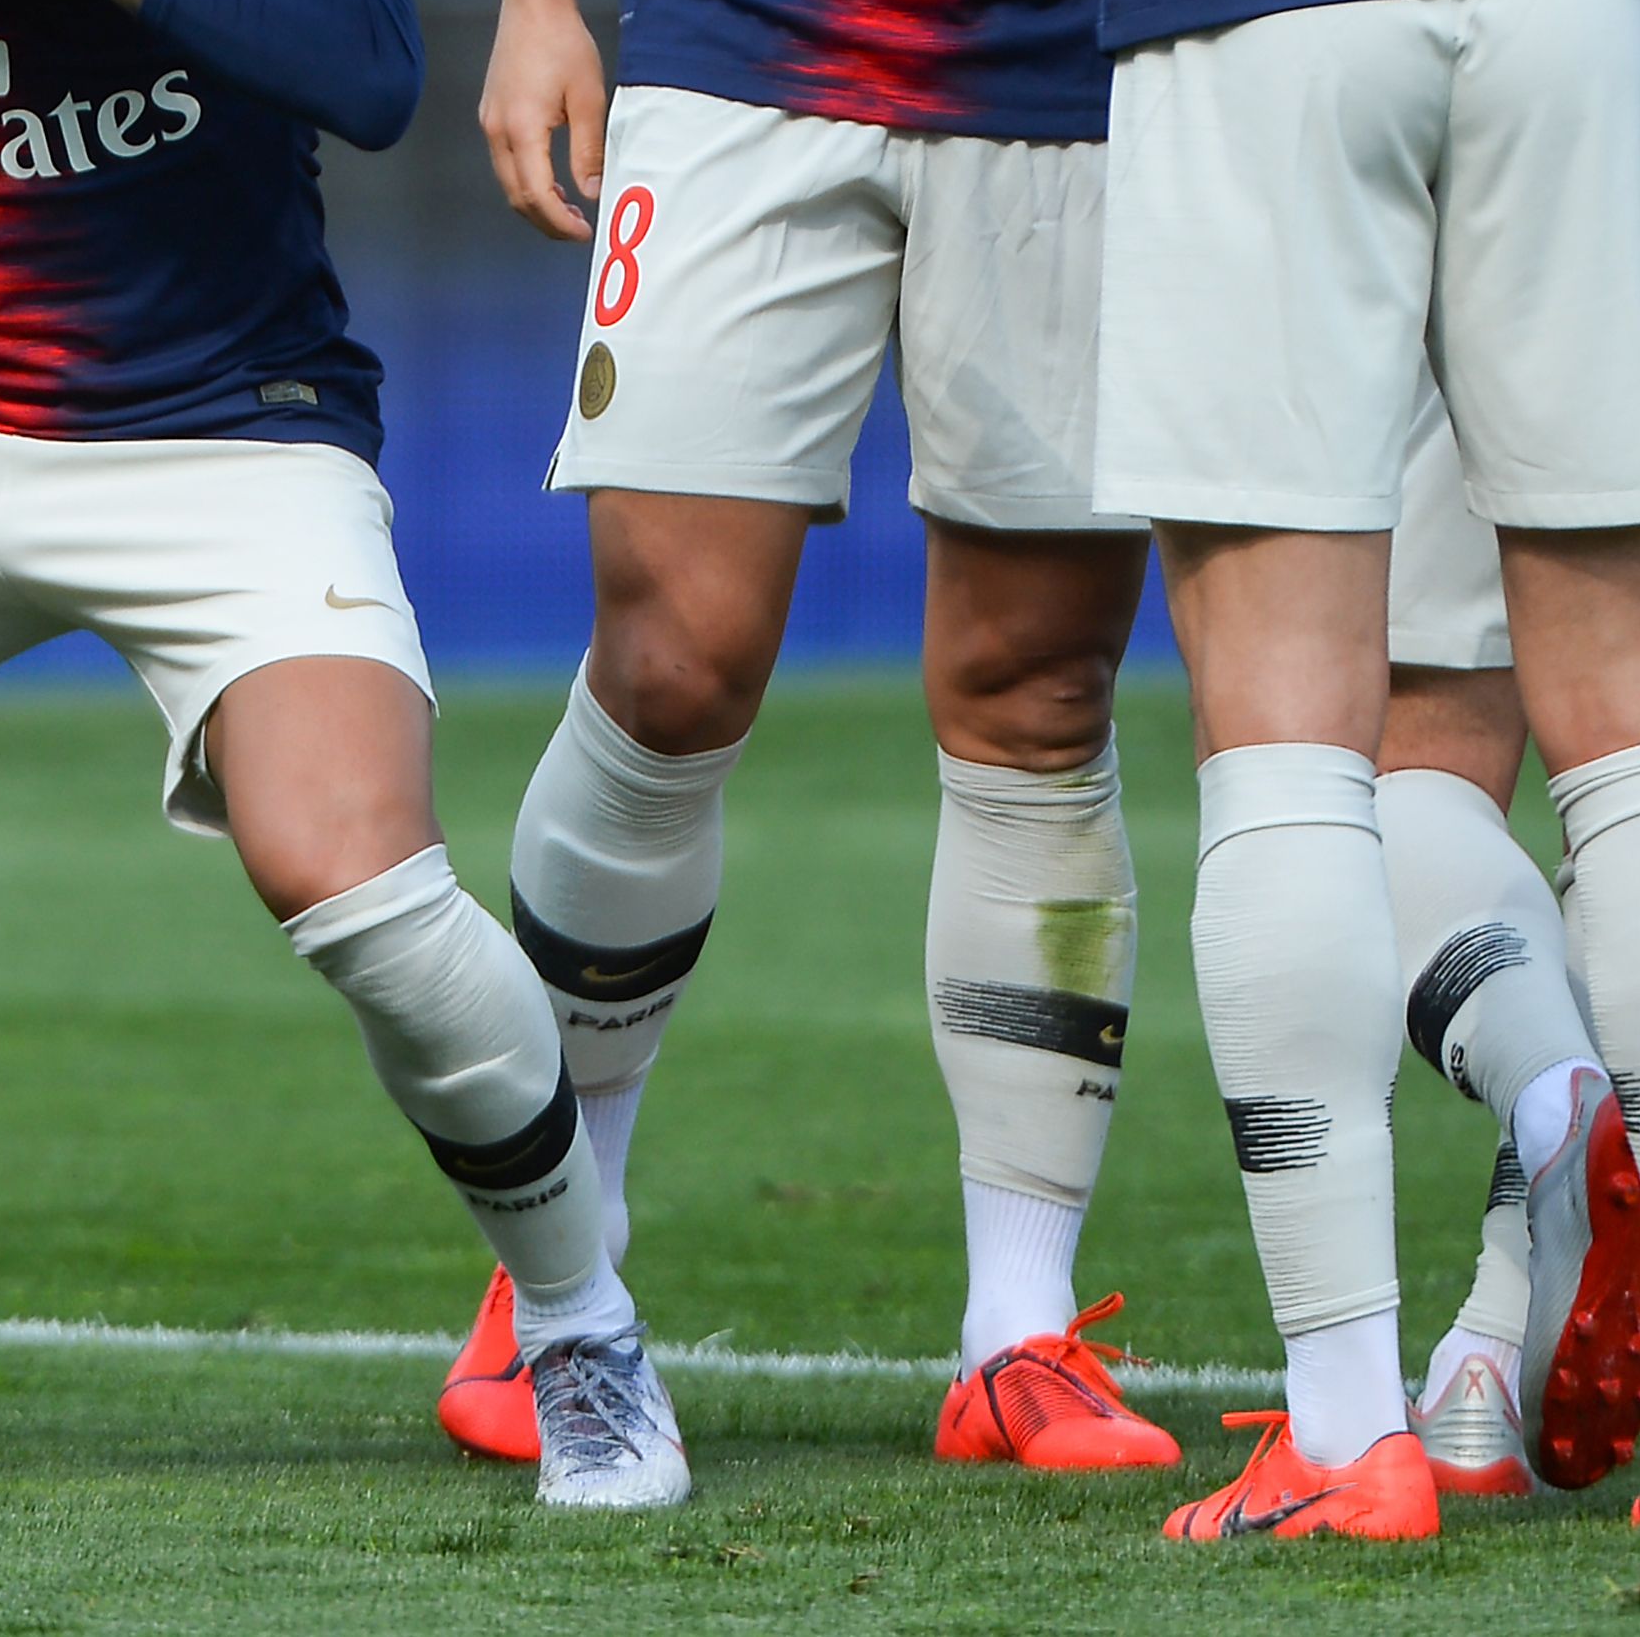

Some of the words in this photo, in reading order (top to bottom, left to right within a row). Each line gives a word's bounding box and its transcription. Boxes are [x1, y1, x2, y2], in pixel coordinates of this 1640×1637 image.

[593, 183, 657, 329] 8
[567, 991, 675, 1031] PARIS
[466, 1176, 569, 1213] PARIS
